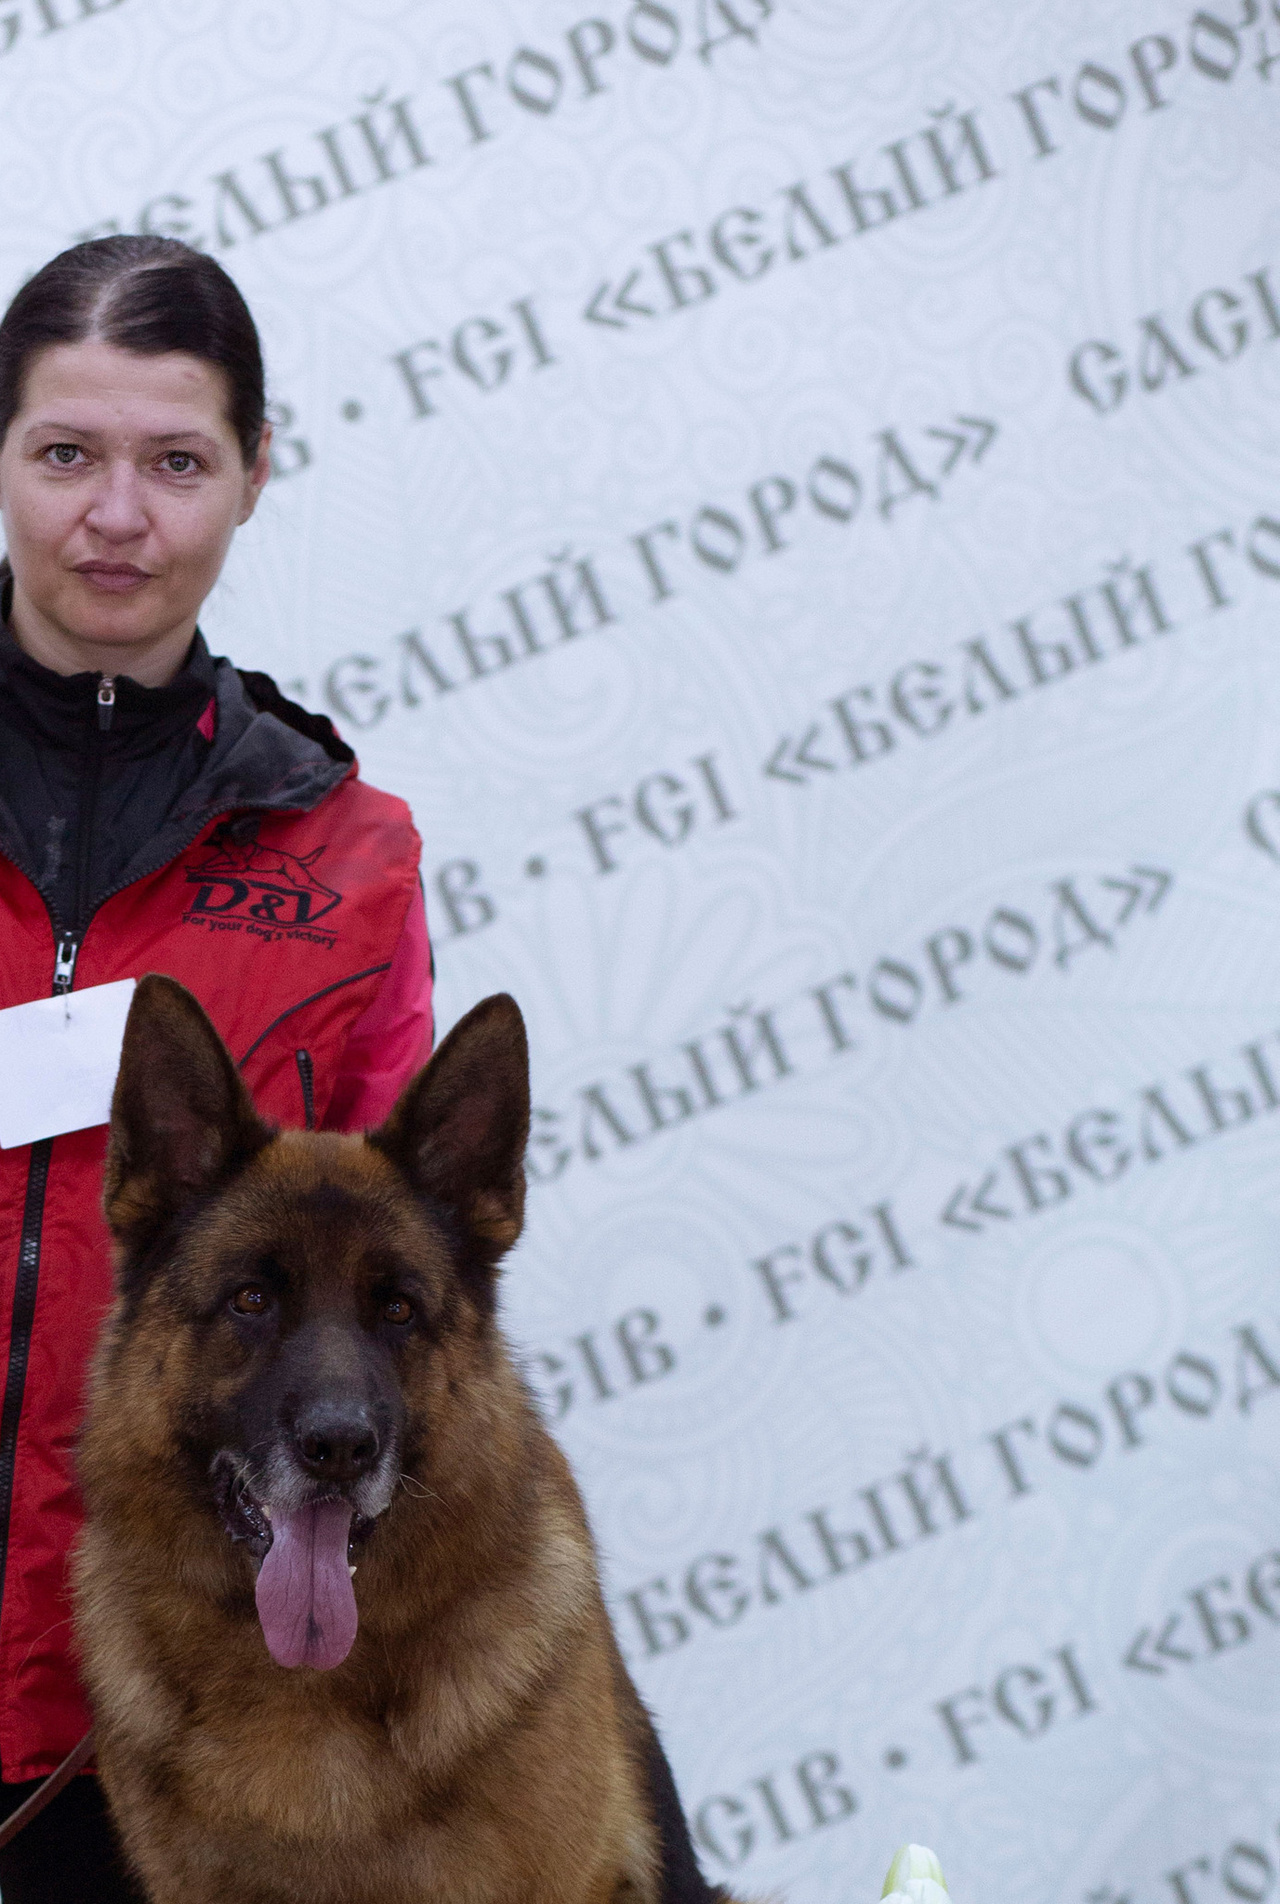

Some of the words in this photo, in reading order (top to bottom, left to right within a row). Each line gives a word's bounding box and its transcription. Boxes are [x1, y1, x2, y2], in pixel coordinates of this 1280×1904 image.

[186, 872, 342, 925] D&V
[182, 915, 206, 926] For
[209, 919, 242, 932] your
[286, 929, 338, 950] victory
